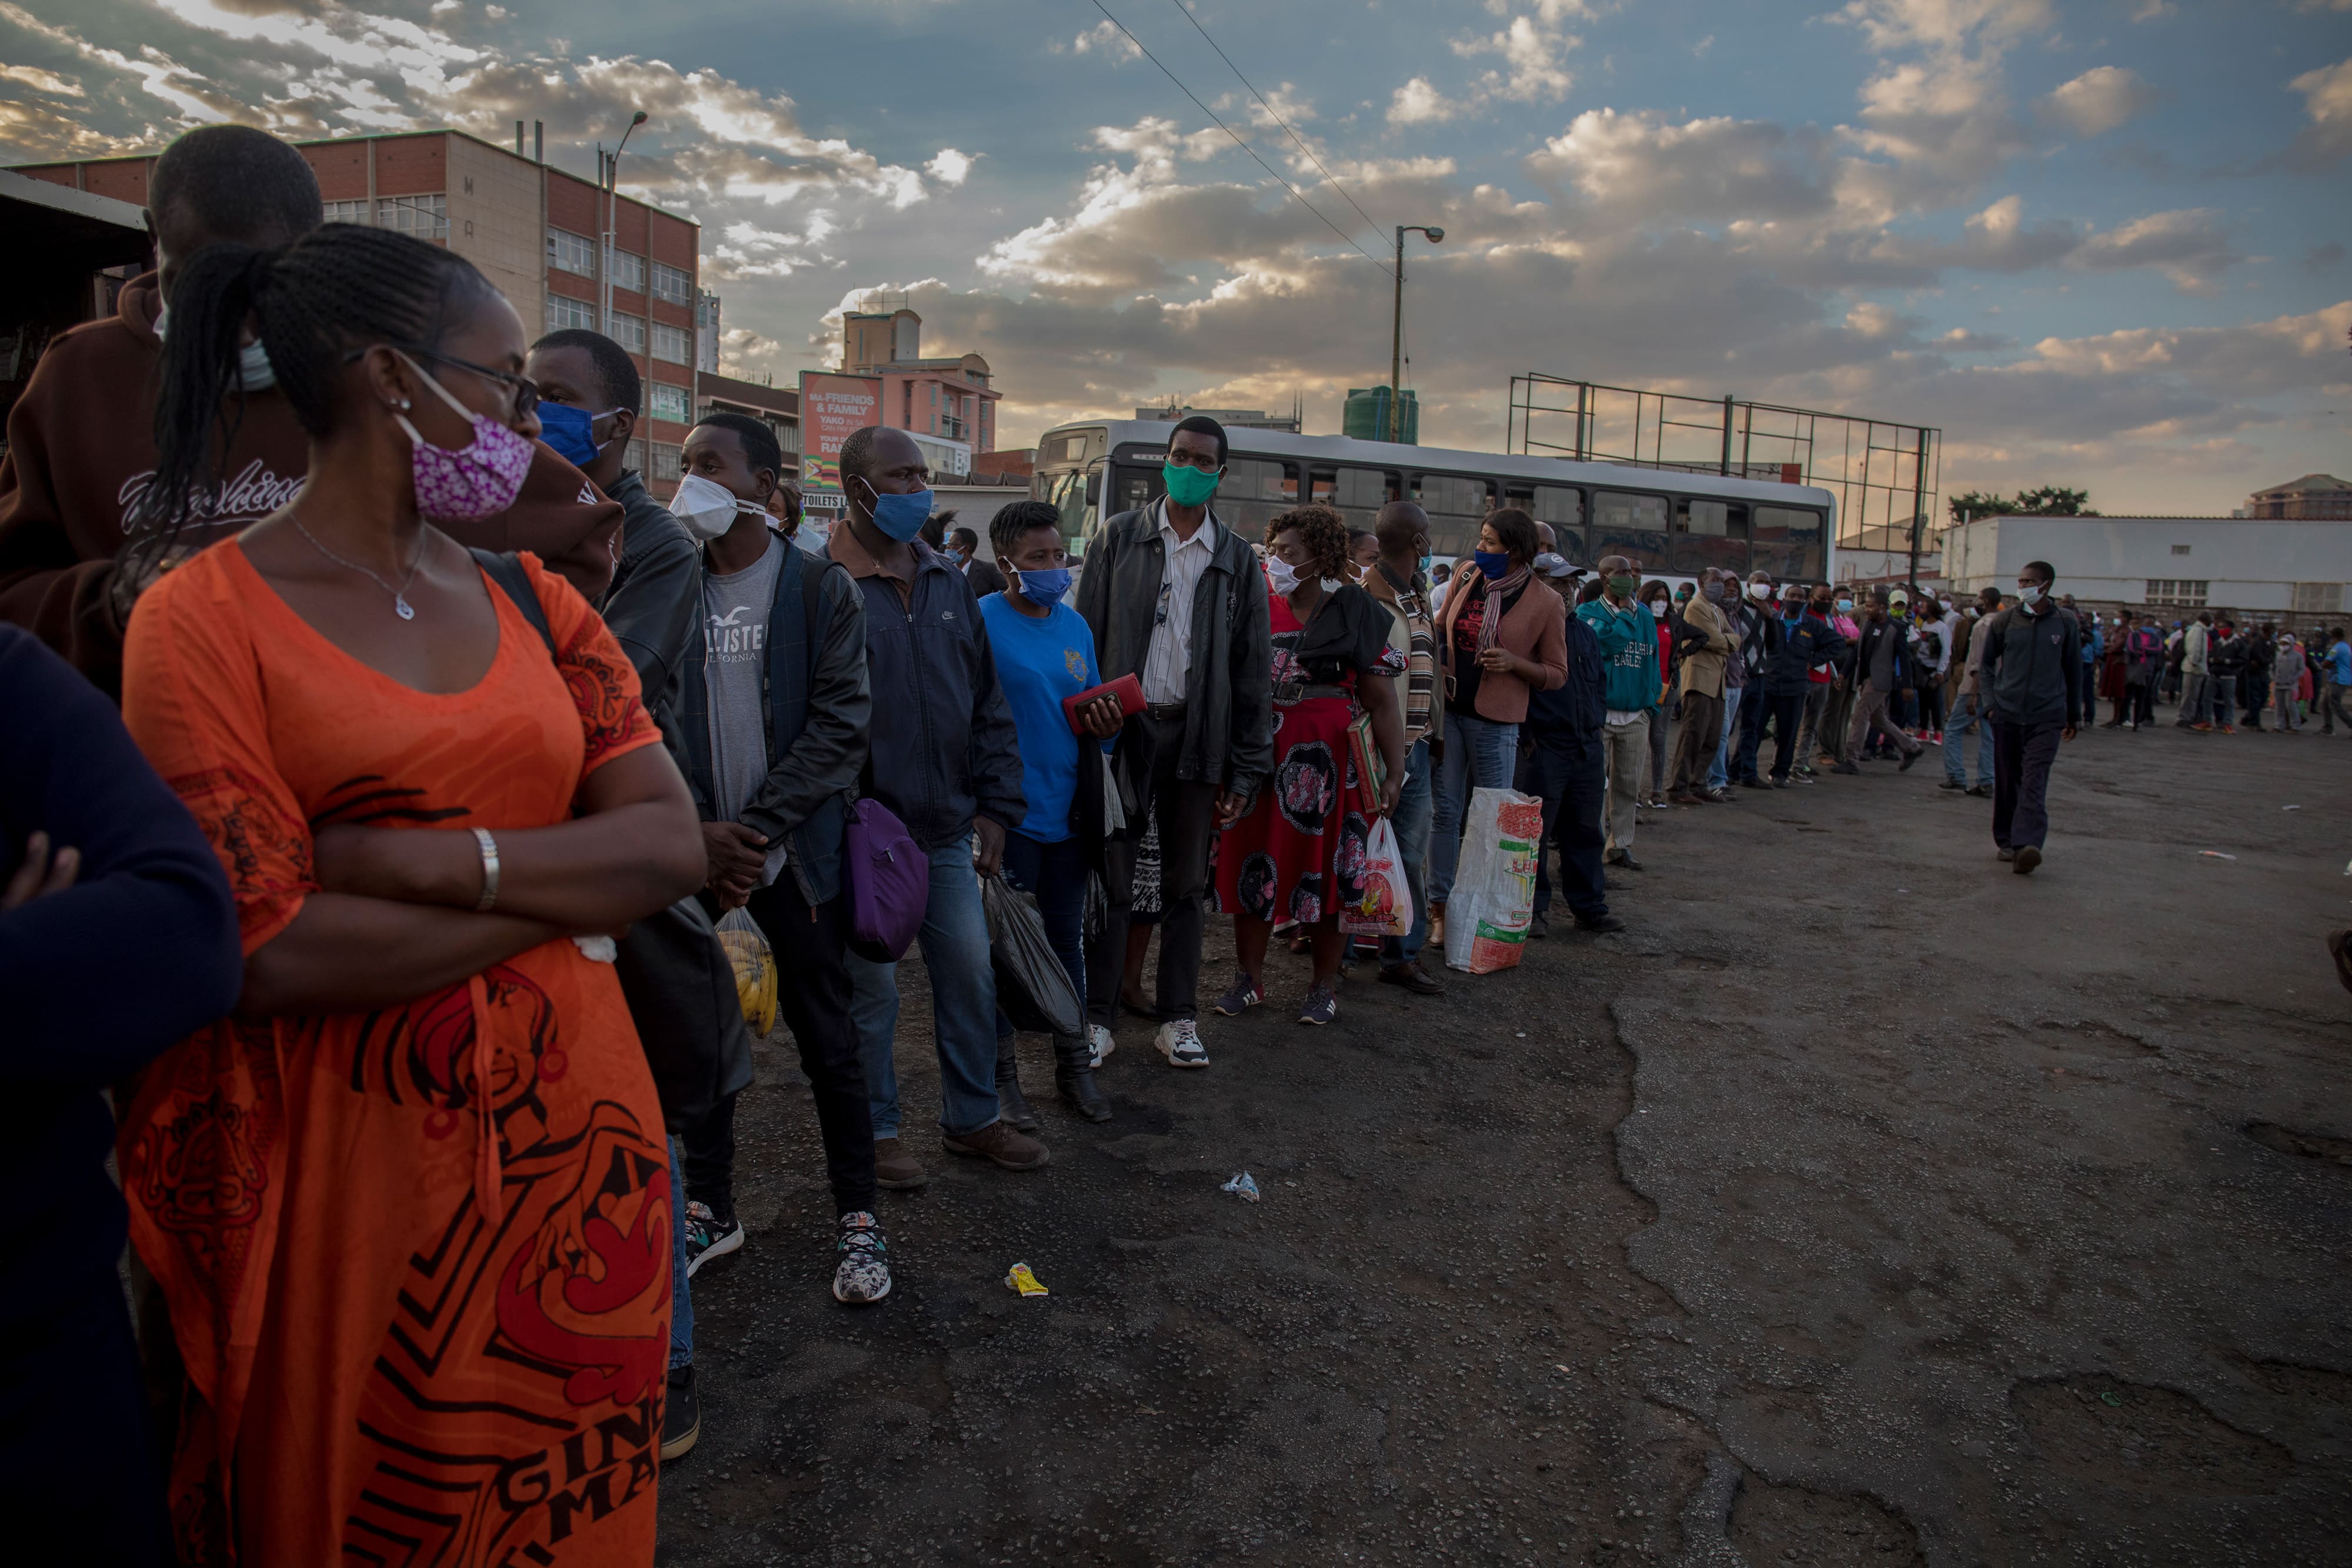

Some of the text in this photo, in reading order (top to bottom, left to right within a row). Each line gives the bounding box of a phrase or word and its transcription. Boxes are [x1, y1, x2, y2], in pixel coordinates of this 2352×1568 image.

[809, 393, 875, 406] MA-FRIENDS
[816, 403, 868, 416] & FAMILY
[820, 416, 844, 425] YAKO
[803, 495, 838, 507] TOILETS
